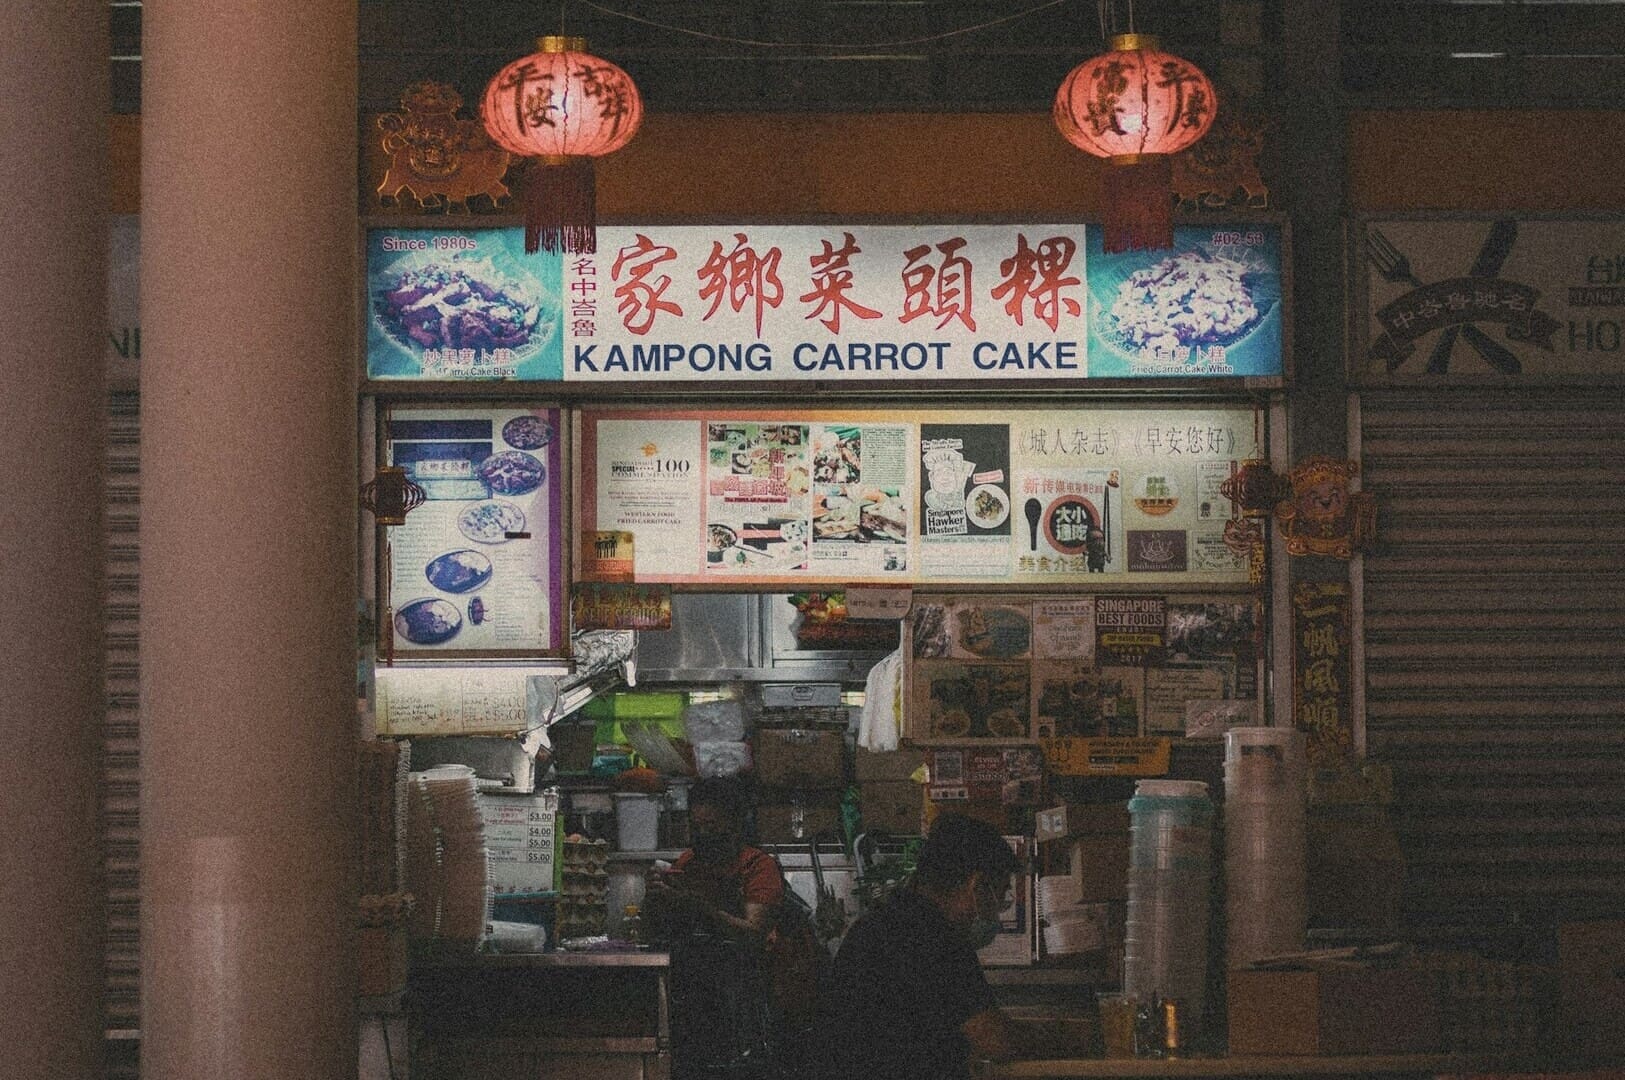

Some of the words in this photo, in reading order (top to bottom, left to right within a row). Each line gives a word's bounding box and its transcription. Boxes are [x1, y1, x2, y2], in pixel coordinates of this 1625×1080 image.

[383, 237, 427, 251] Since
[432, 237, 477, 250] 1980s
[610, 231, 1081, 339] 家鄉菜頭粿
[574, 343, 772, 372] KAMPONG
[793, 342, 950, 371] CARROT
[973, 342, 1078, 370] CAKE
[494, 366, 516, 375] Black
[1156, 364, 1183, 373] Carrot
[1184, 364, 1206, 373] Cake
[1208, 364, 1233, 373] White
[656, 459, 690, 472] 100
[927, 508, 964, 519] Singapore
[927, 517, 964, 527] Hawker
[1096, 599, 1165, 612] SINGAPORE
[1098, 613, 1124, 625] BEST
[1127, 613, 1162, 625] FOODS
[529, 812, 552, 821] $3.00
[529, 827, 551, 835] $4.00
[529, 839, 551, 847] $5.00
[528, 852, 551, 861] $5.00
